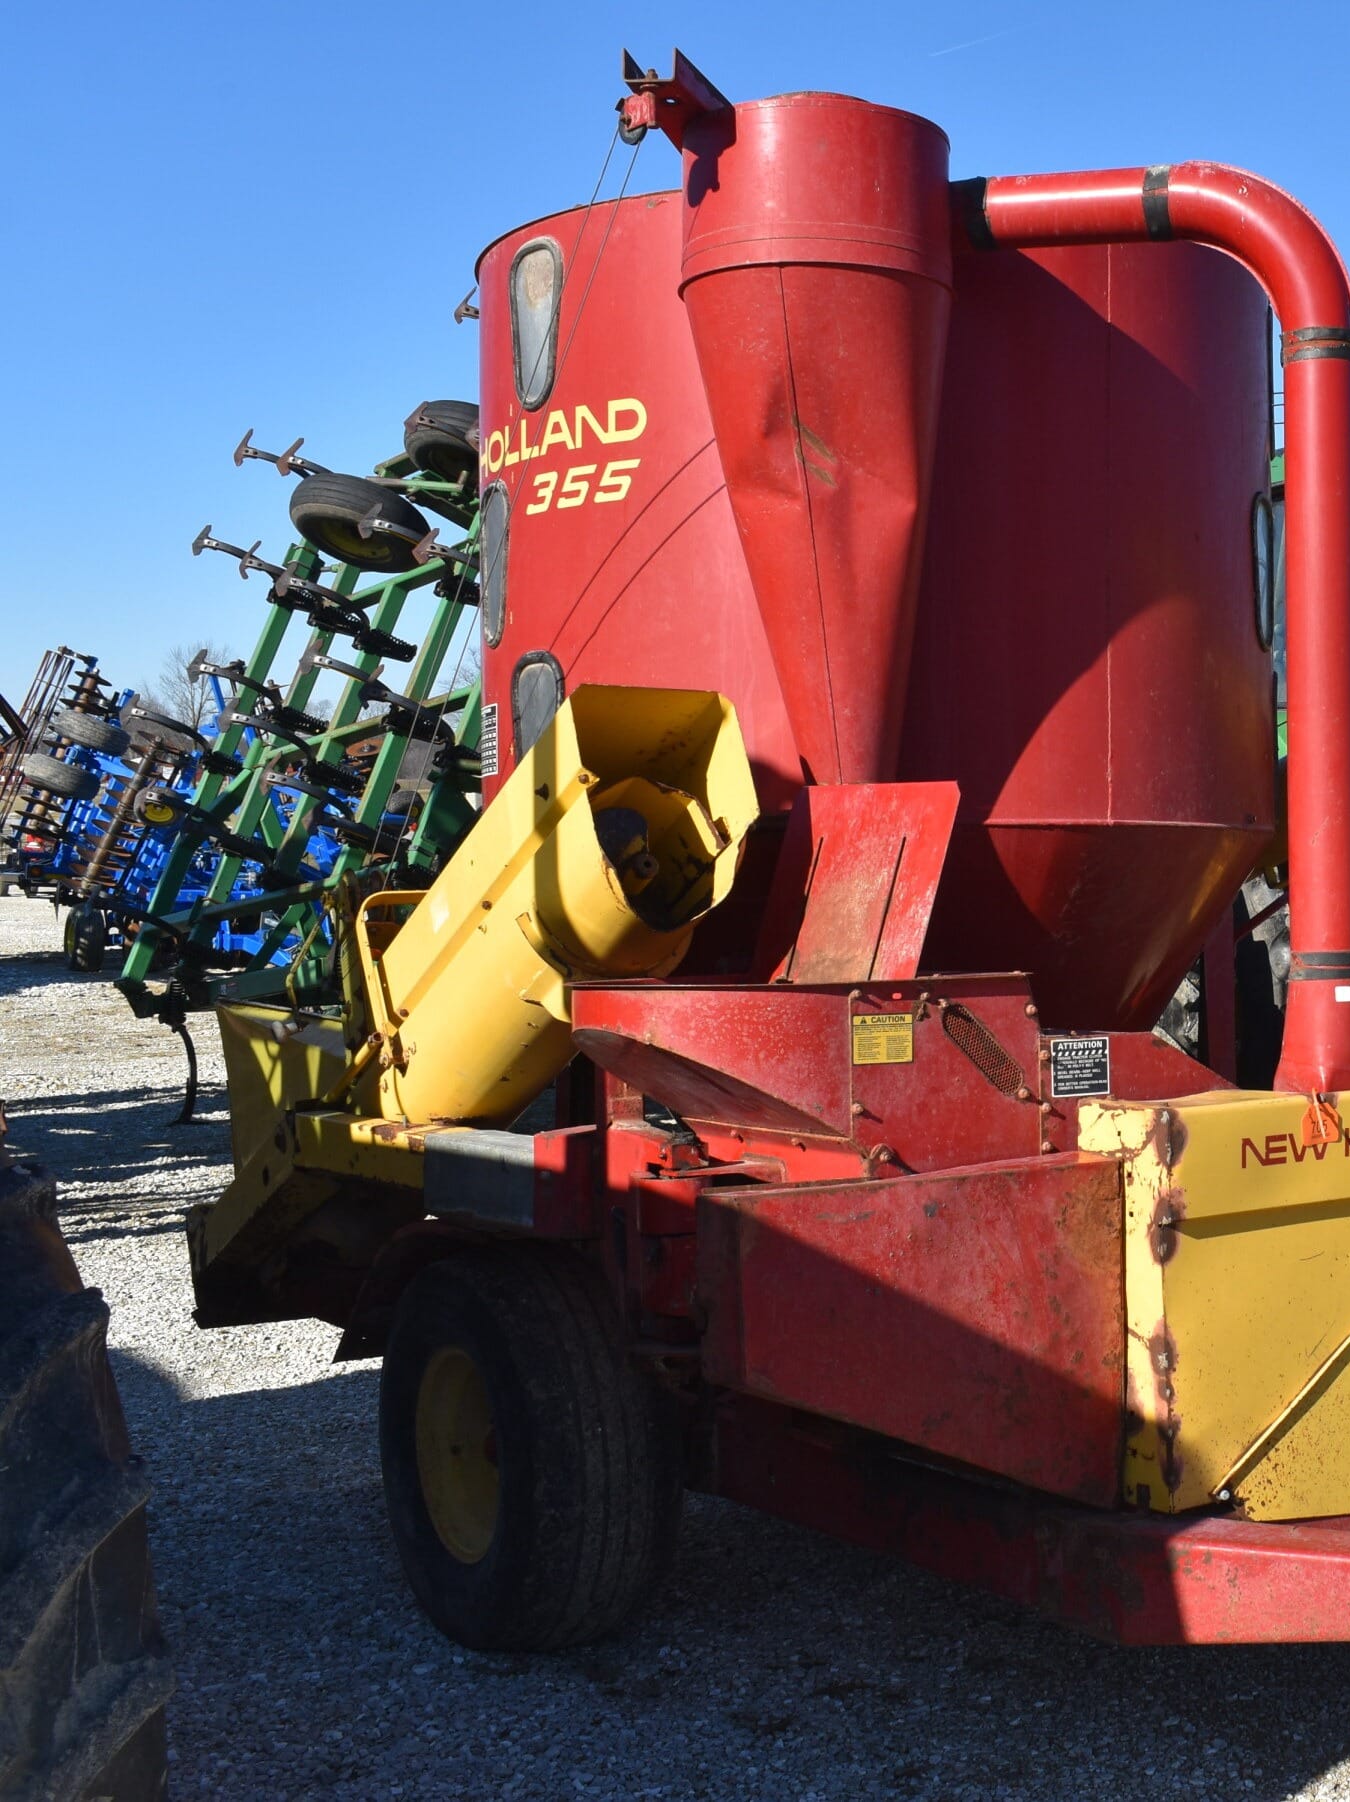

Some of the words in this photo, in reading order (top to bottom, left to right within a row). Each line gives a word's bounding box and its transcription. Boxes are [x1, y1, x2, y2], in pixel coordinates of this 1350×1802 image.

[481, 398, 647, 478] HOLLAND
[526, 458, 641, 516] 355
[870, 1015, 906, 1024] CAUTION
[1057, 1040, 1103, 1050] ATTENTION
[1241, 1133, 1330, 1169] NEW
